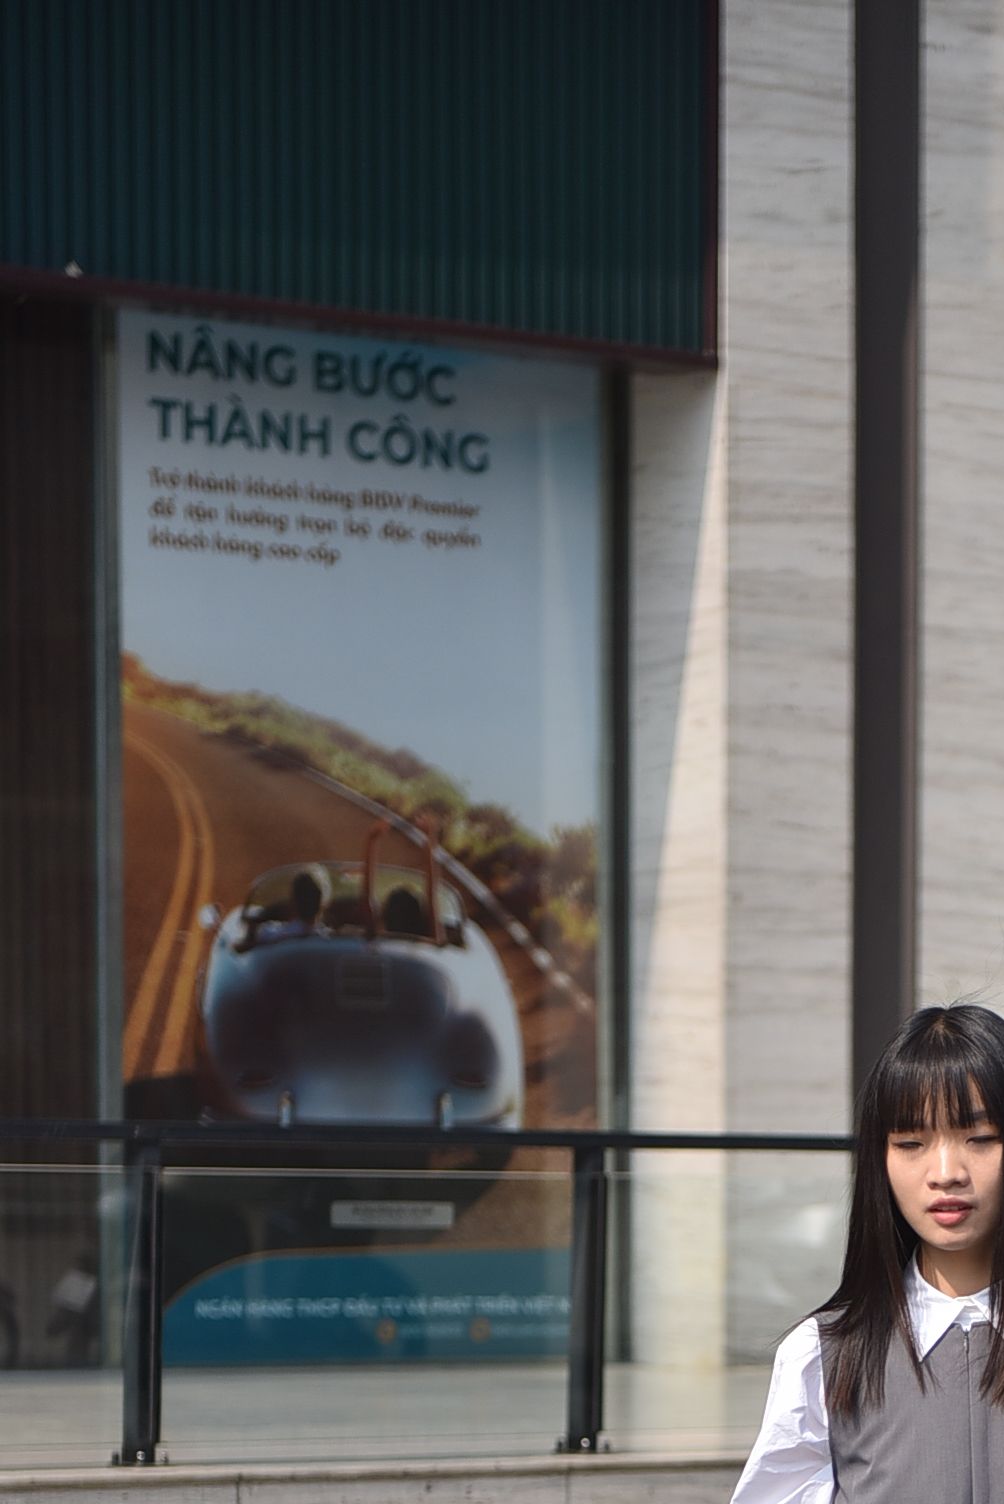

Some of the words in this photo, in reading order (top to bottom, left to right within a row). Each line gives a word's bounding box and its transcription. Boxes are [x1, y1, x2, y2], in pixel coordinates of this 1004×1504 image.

[147, 325, 296, 386] NÂNG
[314, 347, 457, 406] BƯỚC
[148, 394, 331, 456] THÀNH
[346, 411, 491, 474] CÔNG
